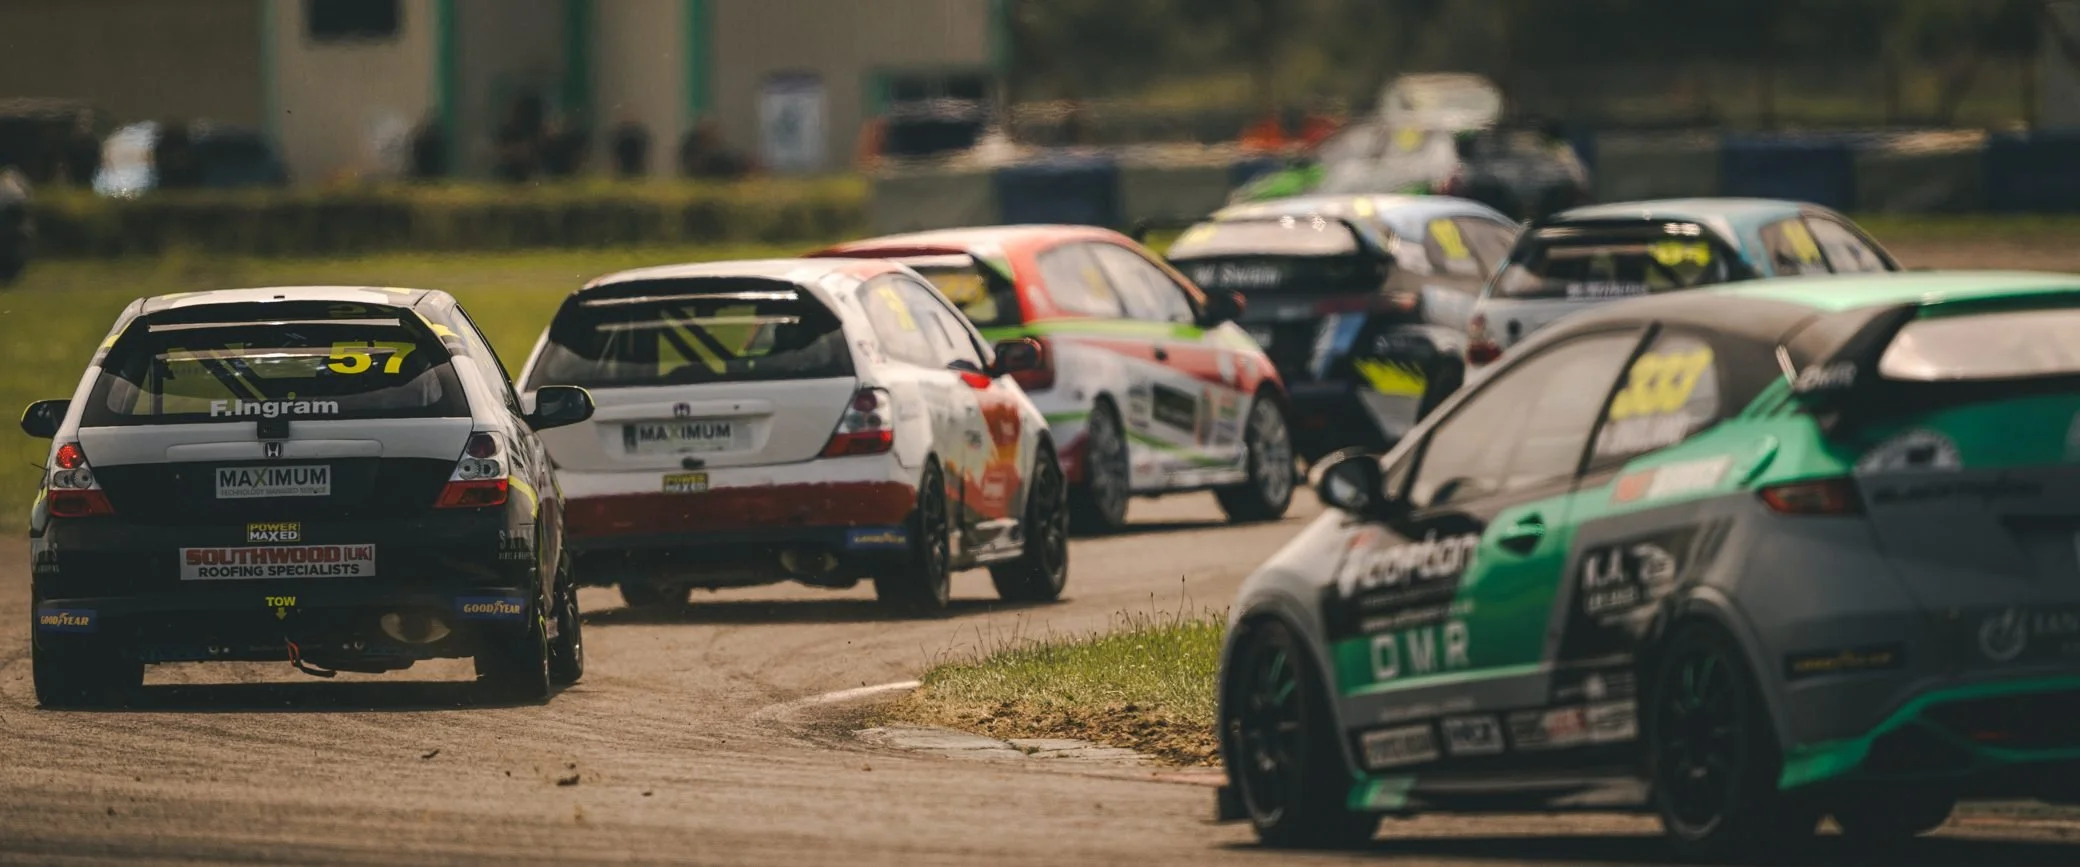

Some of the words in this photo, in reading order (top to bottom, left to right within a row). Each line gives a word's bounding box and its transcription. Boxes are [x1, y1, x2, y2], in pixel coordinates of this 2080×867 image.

[328, 341, 416, 375] 57
[210, 400, 339, 418] F.Ingram
[640, 423, 731, 441] MAXIMUM
[220, 467, 327, 488] MAXIMUM
[221, 488, 265, 497] TECHNOLOGY
[266, 487, 299, 495] MANAGED
[300, 486, 327, 494] SERVICE
[250, 523, 298, 532] POWER
[250, 531, 298, 542] MAXED
[186, 547, 342, 566] SOUTHWOOD
[199, 566, 263, 578] ROOFING
[268, 564, 360, 577] SPECIALISTS
[265, 597, 296, 607] TOW
[463, 600, 520, 614] GOODYEAR
